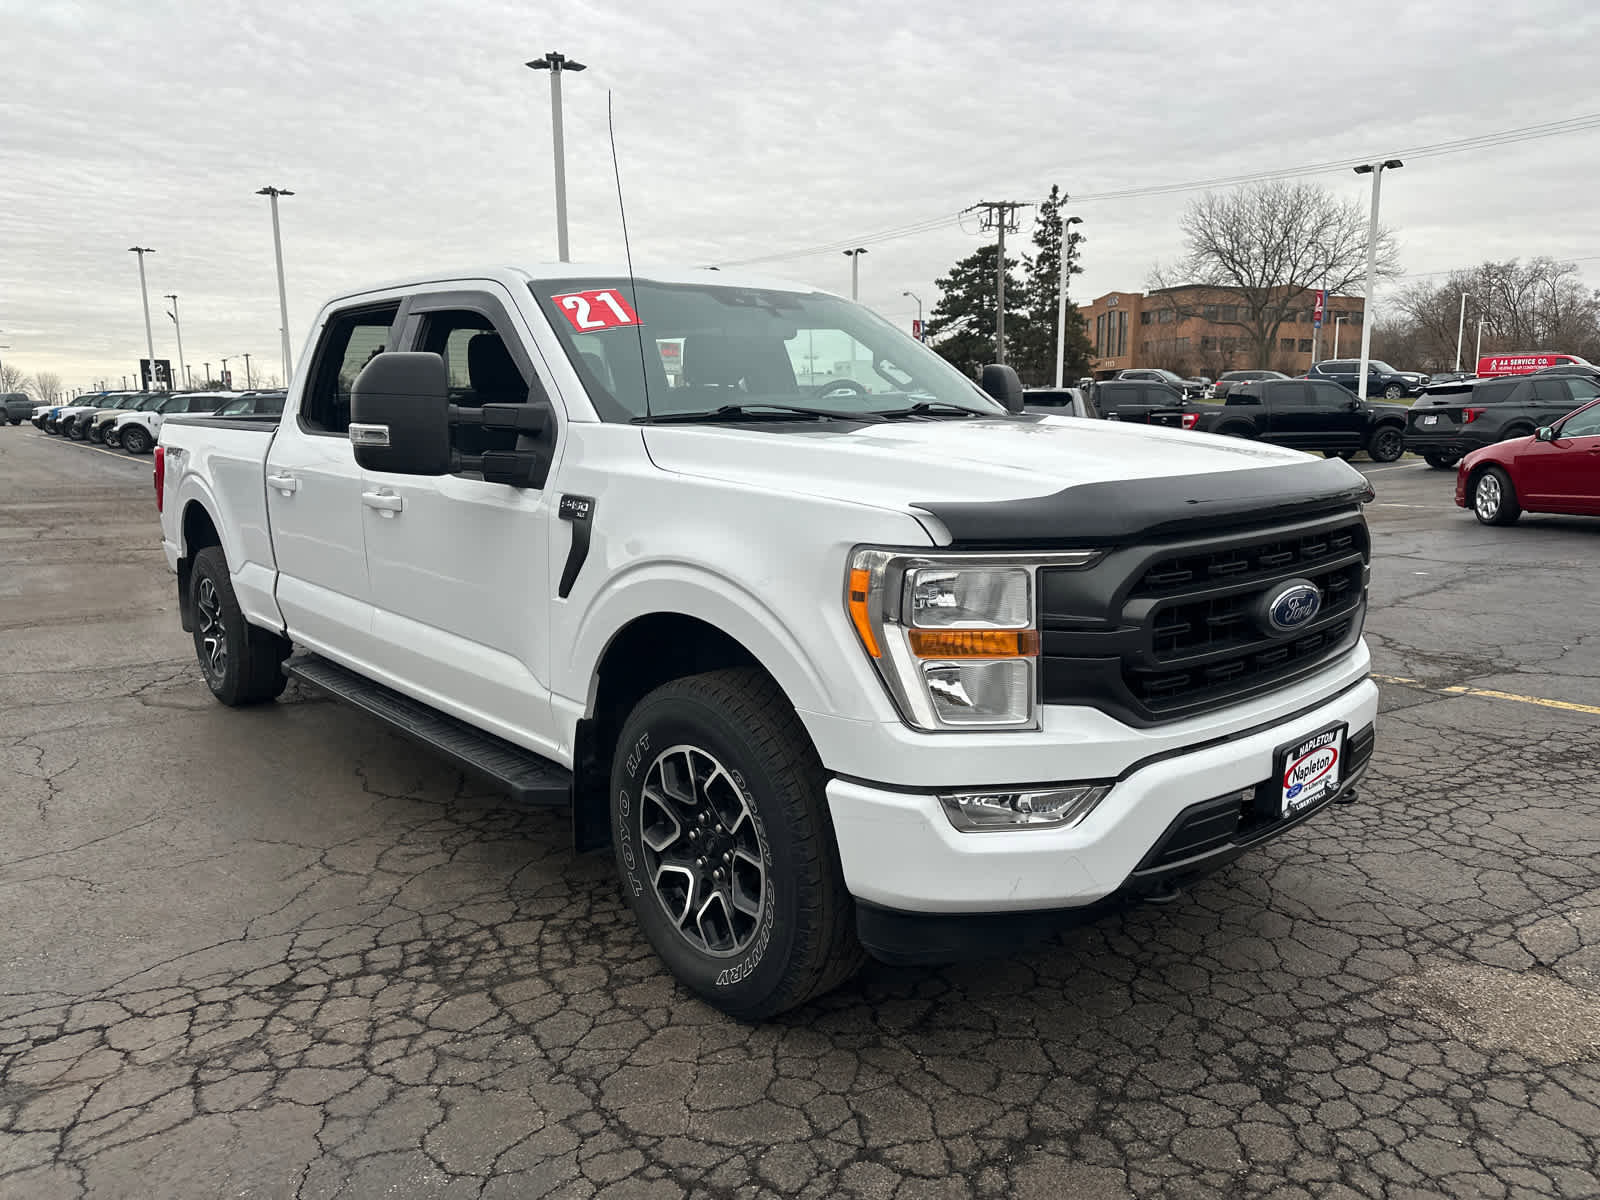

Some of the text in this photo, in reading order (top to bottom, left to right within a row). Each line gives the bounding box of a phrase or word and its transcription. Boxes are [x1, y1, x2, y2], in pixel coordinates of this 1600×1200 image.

[562, 292, 632, 329] 21
[1285, 595, 1313, 622] Ford
[1300, 731, 1335, 756] NAPLETON
[1292, 756, 1330, 783] Napleton
[619, 733, 650, 897] TOYO H/T
[716, 879, 776, 986] COUNTRY
